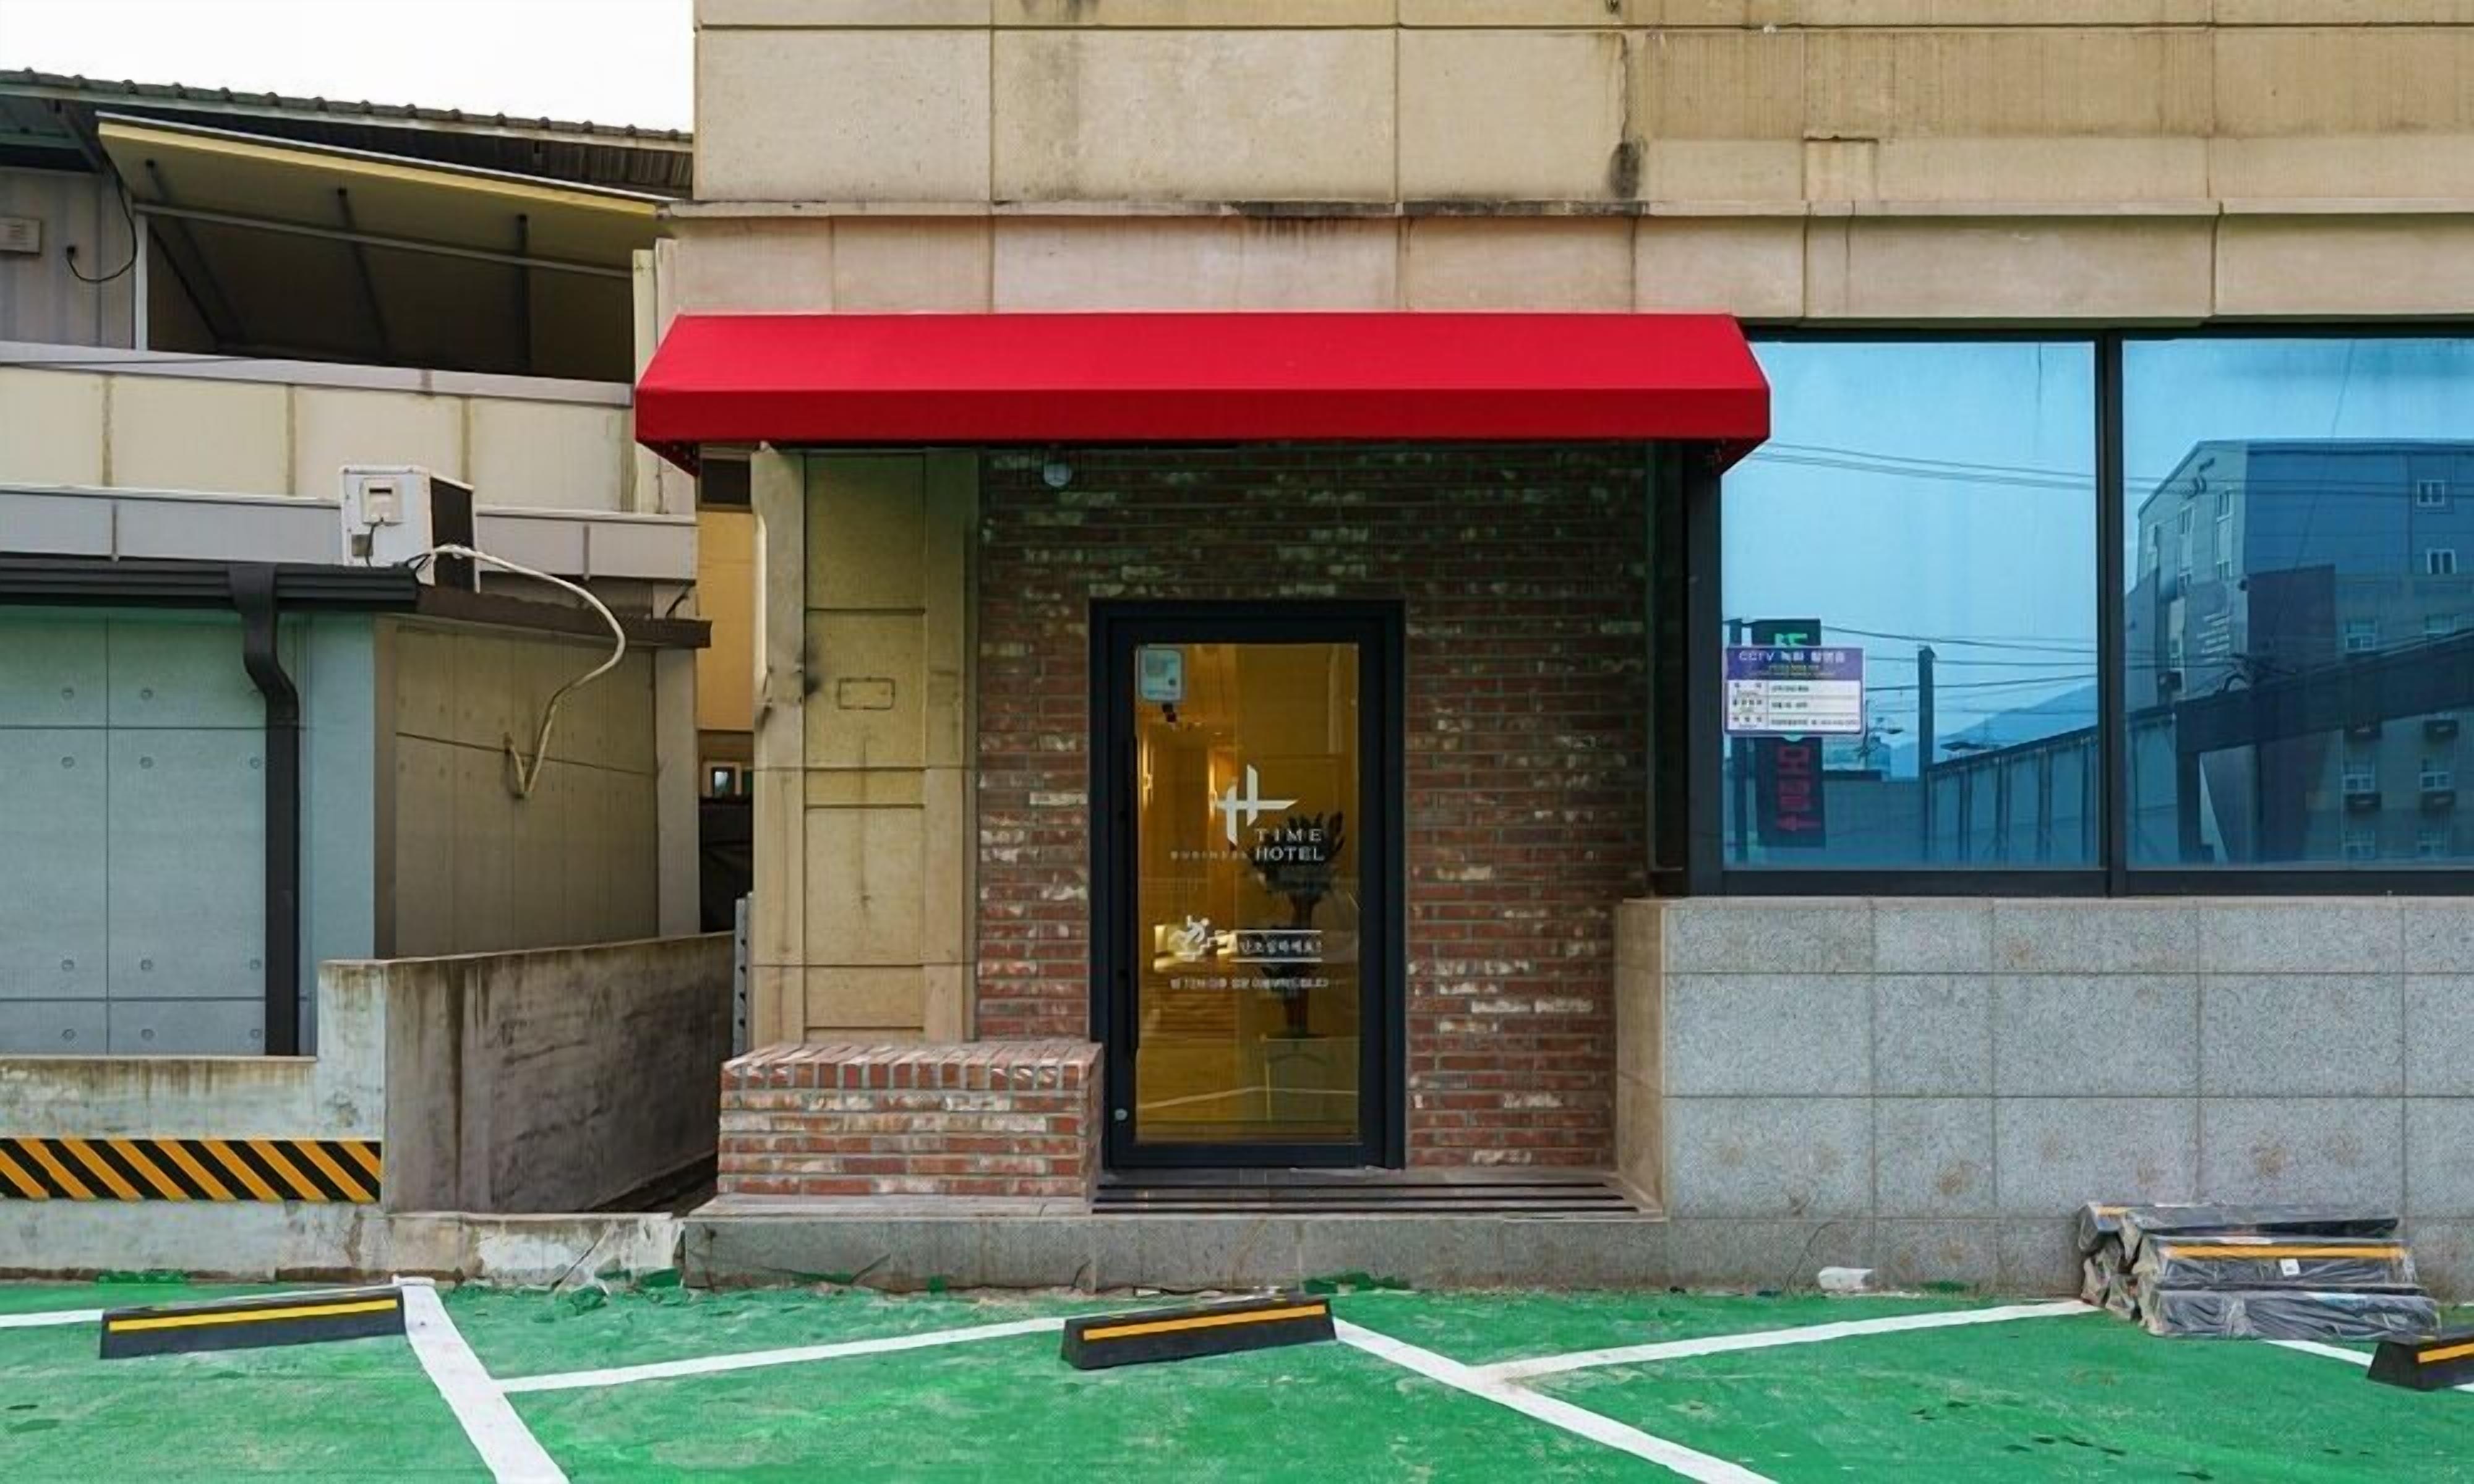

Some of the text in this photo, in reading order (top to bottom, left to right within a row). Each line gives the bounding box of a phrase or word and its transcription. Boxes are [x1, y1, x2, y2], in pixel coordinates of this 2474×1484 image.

[1739, 651, 1774, 662] CCTV
[1255, 829, 1322, 842] TIME
[1256, 846, 1325, 861] HOTEL
